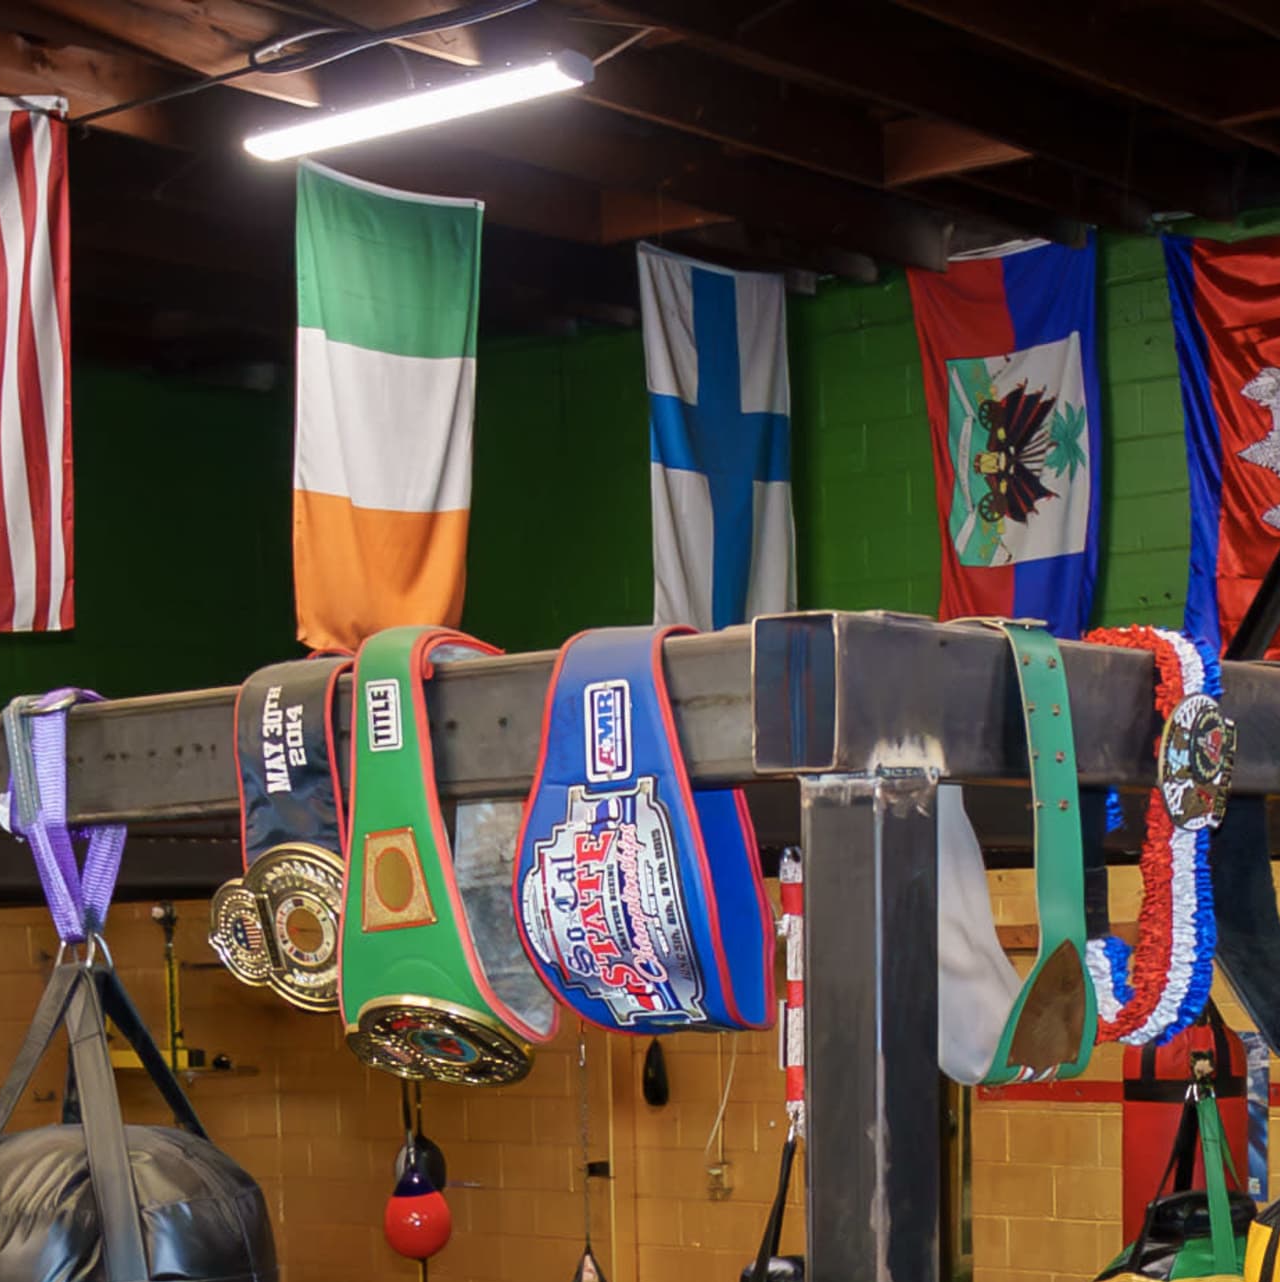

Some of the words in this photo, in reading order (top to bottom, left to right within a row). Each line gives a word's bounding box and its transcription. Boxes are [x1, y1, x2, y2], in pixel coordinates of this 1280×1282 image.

[262, 685, 283, 738] 30TH
[286, 704, 307, 766] 2014
[371, 689, 391, 744] TITLE
[263, 741, 291, 793] MAY
[550, 855, 578, 912] Cal
[575, 831, 646, 988] STATE
[617, 823, 668, 982] Championships
[568, 927, 600, 976] So
